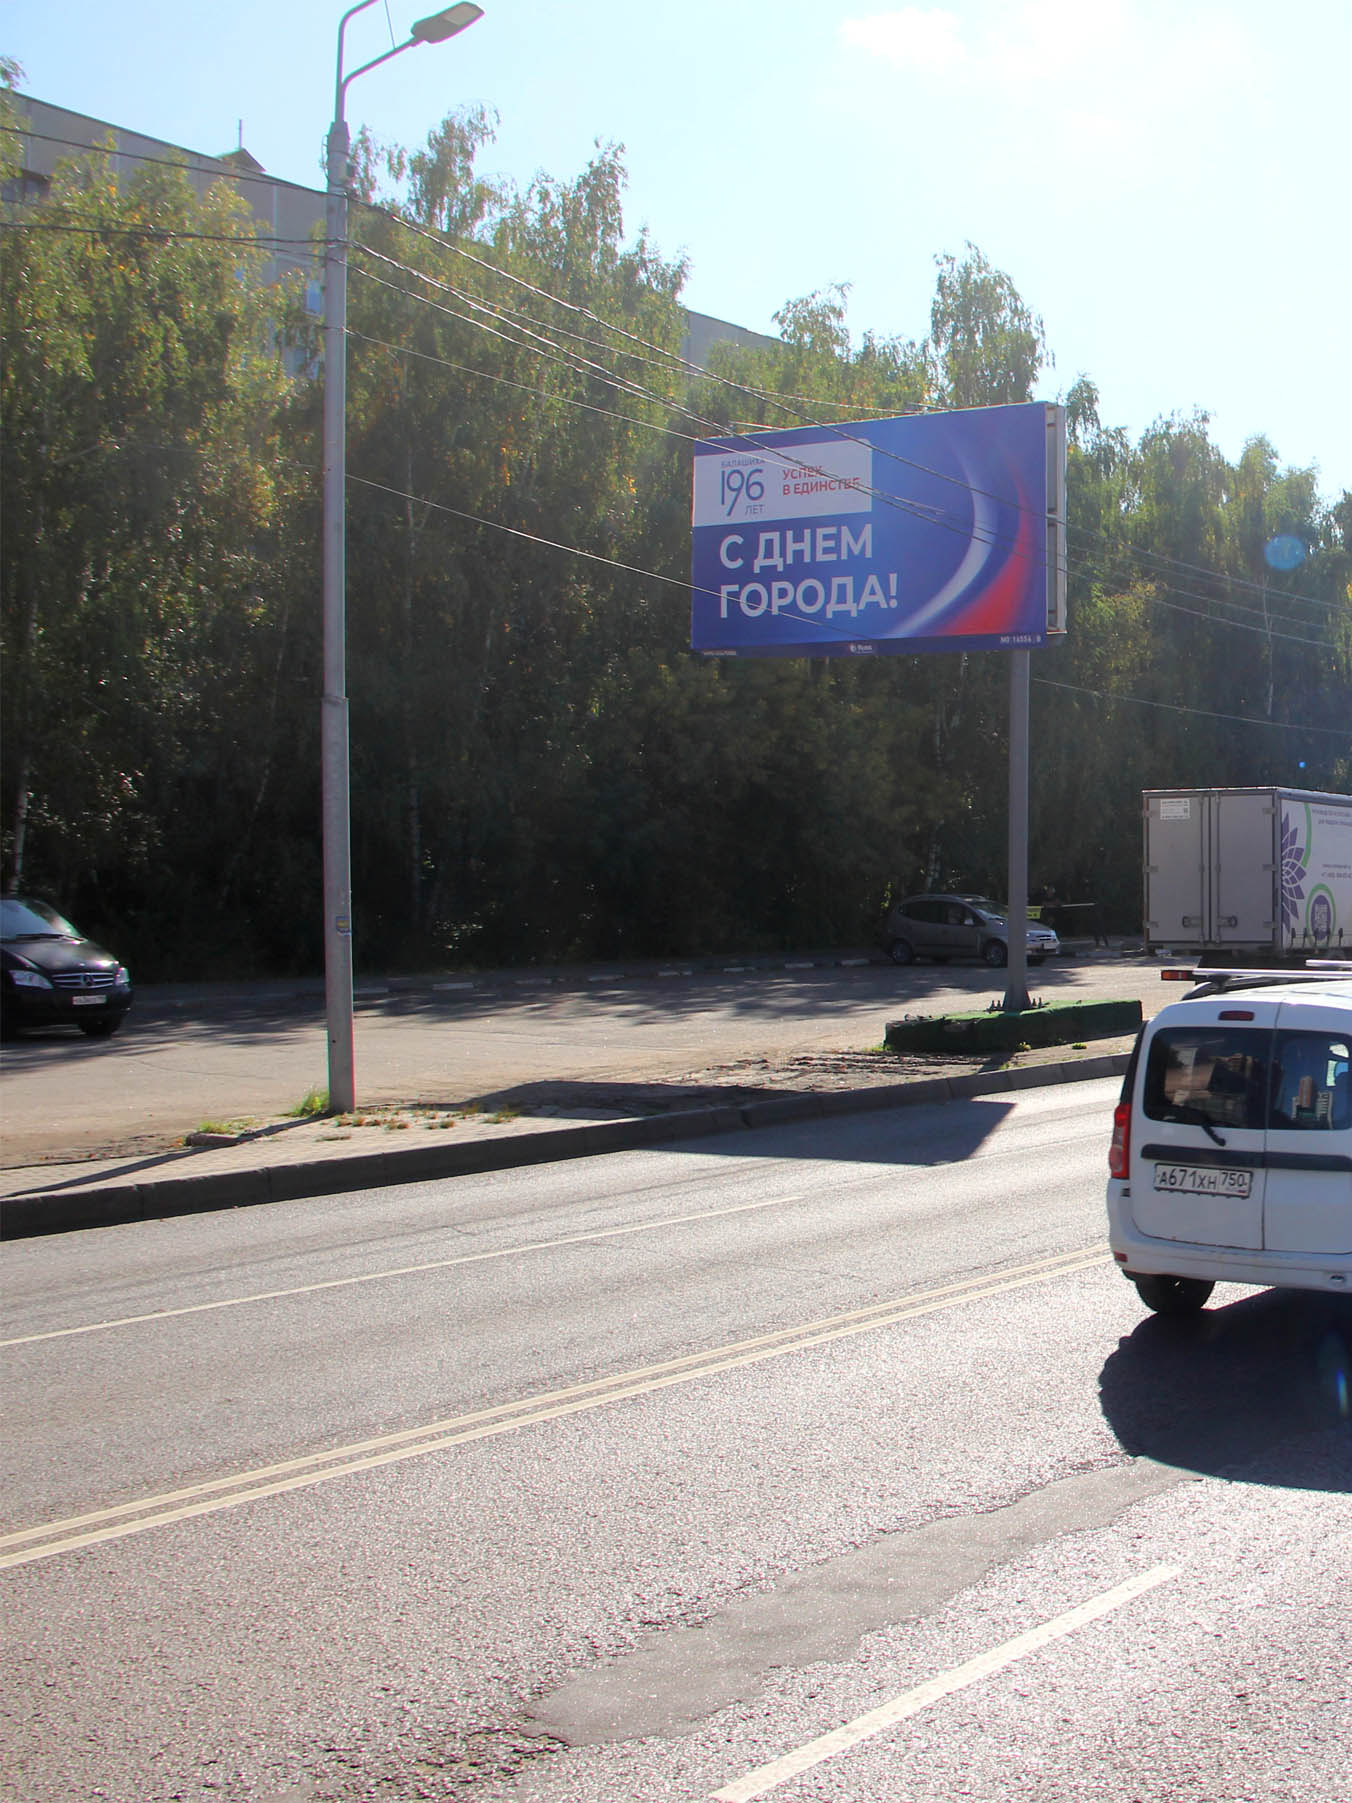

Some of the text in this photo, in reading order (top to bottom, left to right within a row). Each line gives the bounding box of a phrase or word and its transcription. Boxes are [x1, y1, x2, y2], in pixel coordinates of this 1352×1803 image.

[720, 468, 765, 516] 196
[783, 484, 791, 496] В
[745, 504, 765, 515] ЛЕТ
[719, 523, 873, 574] С ДНЕМ
[719, 572, 898, 619] ГОРОДА!
[1159, 1168, 1246, 1190] А671ХН 750
